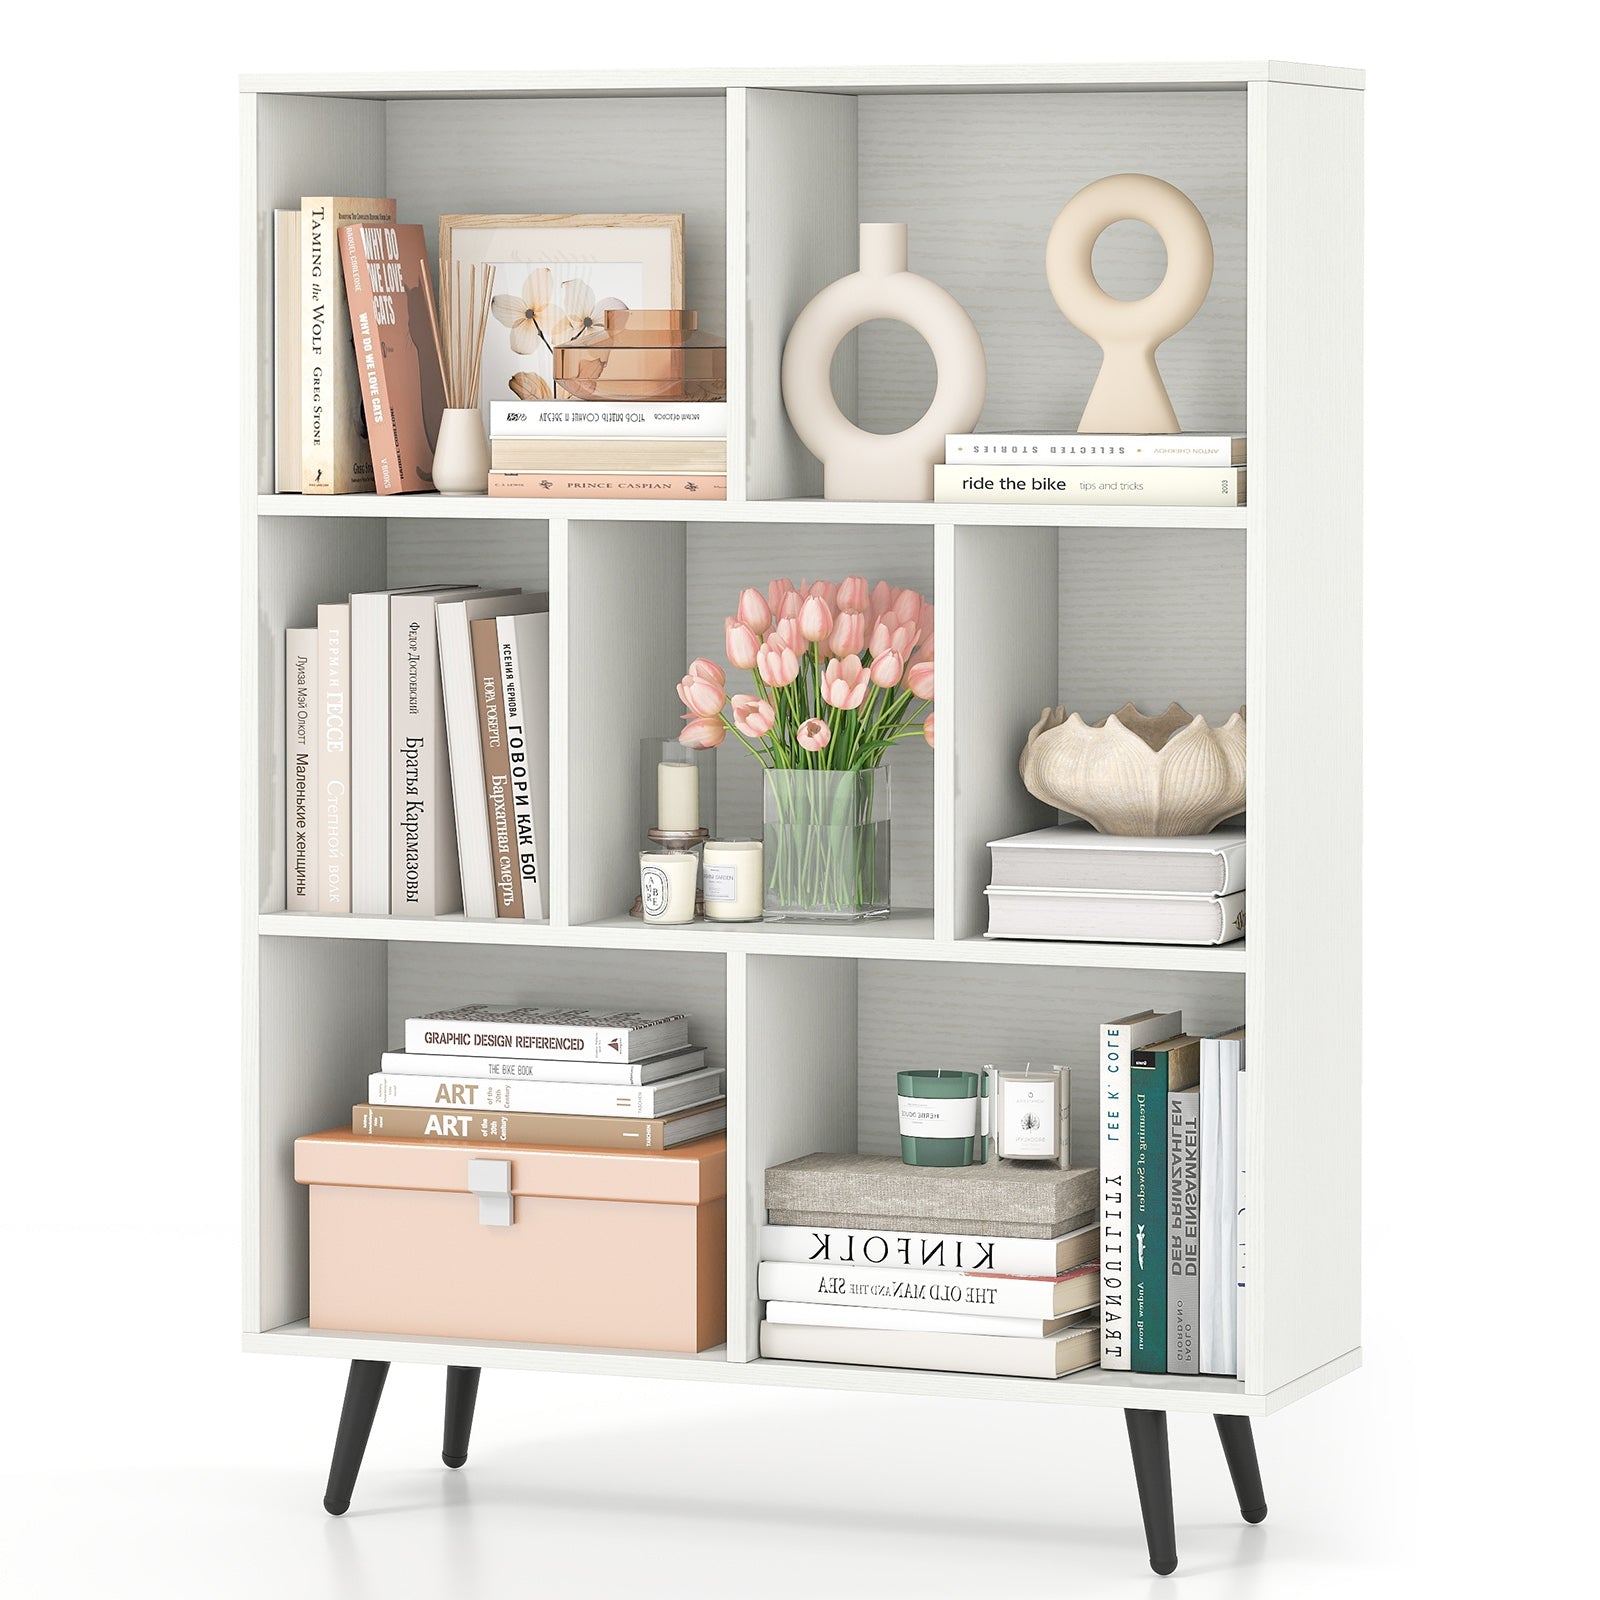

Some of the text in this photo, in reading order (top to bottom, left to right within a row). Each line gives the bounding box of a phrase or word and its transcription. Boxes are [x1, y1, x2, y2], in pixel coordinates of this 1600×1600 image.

[360, 228, 400, 260] WHY DO
[312, 283, 321, 302] the
[366, 263, 406, 293] WE LOVE
[372, 296, 396, 325] CATS
[312, 304, 325, 356] WOLF
[358, 312, 384, 424] WHY DO WE LOVE CATS
[312, 366, 323, 446] GREG STONE
[974, 445, 1126, 455] SELECTED STORIES
[962, 476, 1067, 492] ride the bike
[1079, 481, 1144, 493] tips and tricks
[1221, 479, 1229, 495] 2003
[326, 628, 344, 752] ГЕРМАН ГЕССЕ
[483, 676, 496, 702] НОРА
[502, 644, 518, 718] КСЕНИЯ ЧЕРНОВА
[297, 656, 308, 746] Луиза Мэй Олкотт
[400, 736, 424, 903] Братья Карамазовы
[508, 726, 537, 884] ГОВОРИ КАК БОГ
[294, 753, 309, 896] Маленькие женщины
[491, 774, 514, 906] Бархатная смерть
[424, 1031, 470, 1048] GRAPHIC
[474, 1033, 513, 1049] DESIGN
[516, 1035, 585, 1051] REFERENCED
[488, 1064, 534, 1076] THE BIKE BOOK
[434, 1083, 478, 1104] ART
[424, 1114, 473, 1137] ART
[500, 1116, 508, 1140] Century
